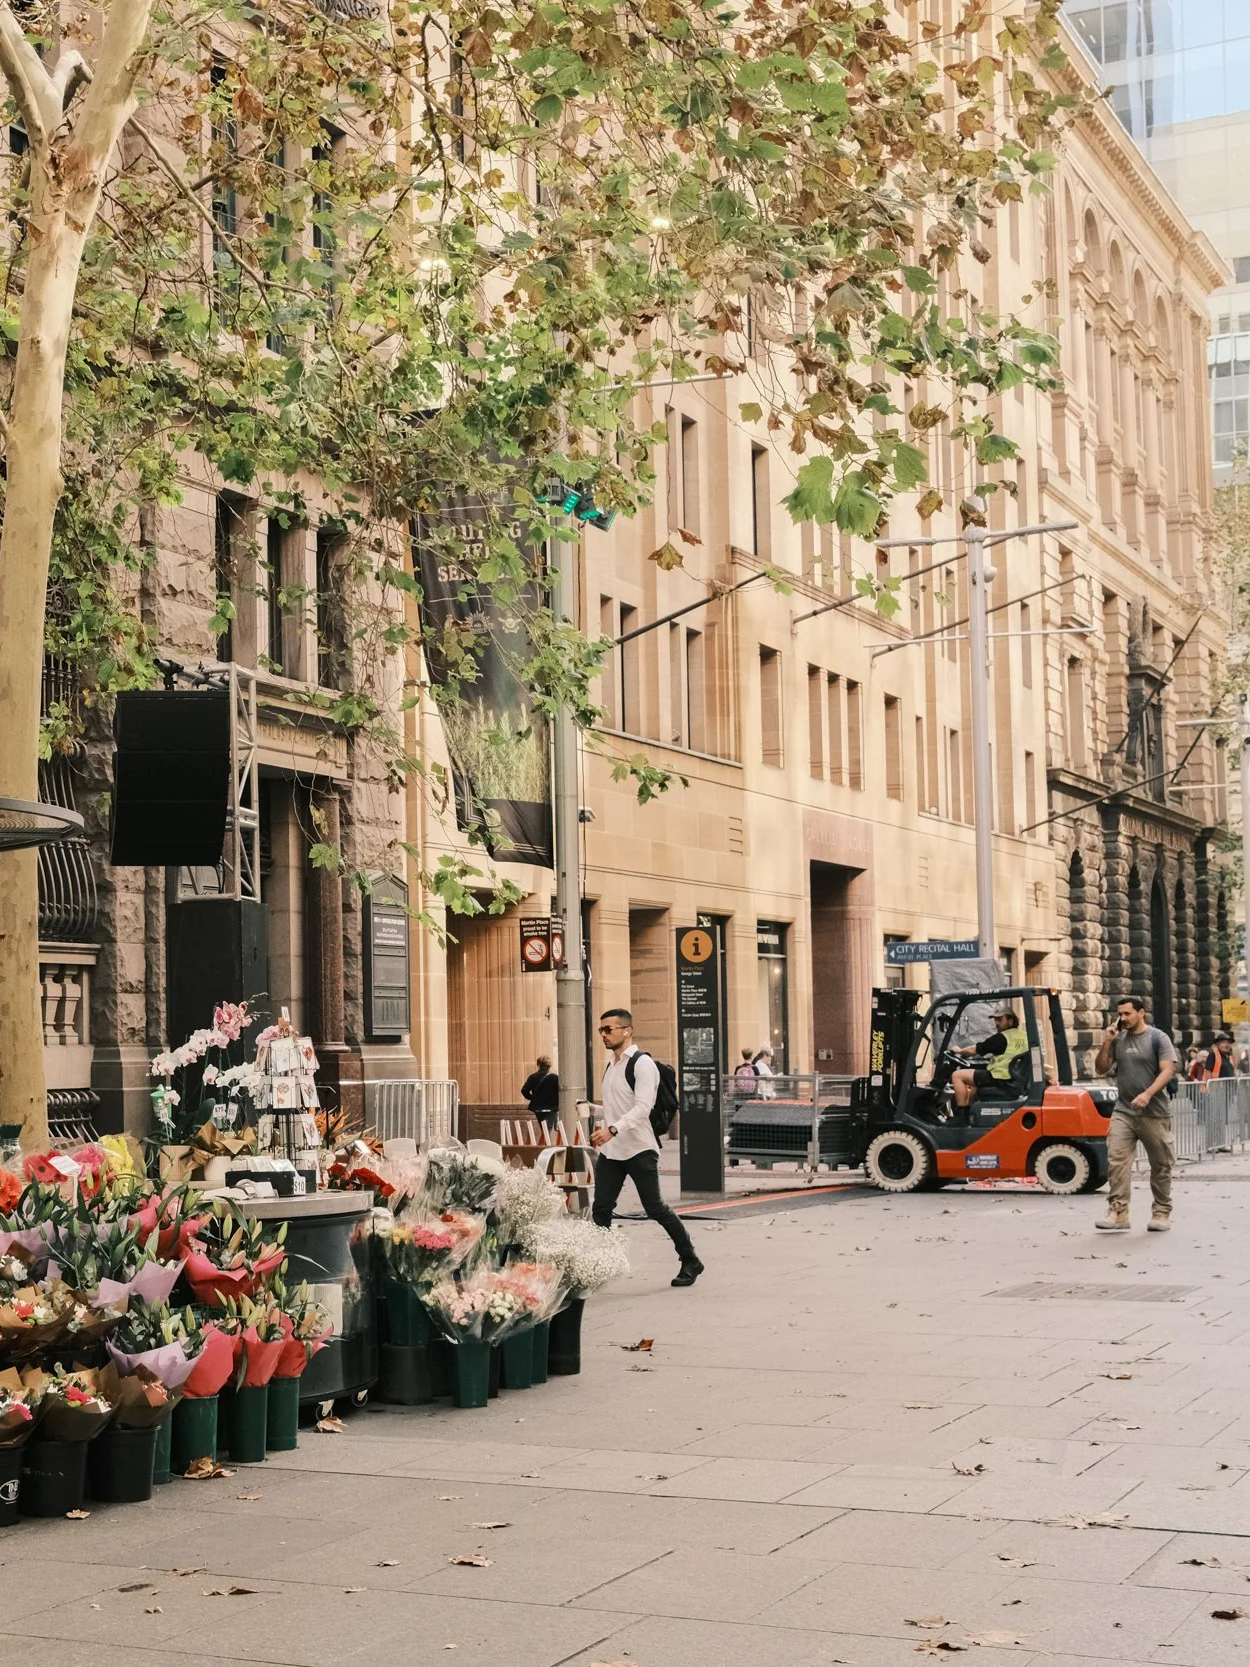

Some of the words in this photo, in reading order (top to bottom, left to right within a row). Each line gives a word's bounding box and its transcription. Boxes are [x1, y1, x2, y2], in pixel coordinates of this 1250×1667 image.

[896, 945, 917, 954] CITY
[918, 944, 951, 953] RECITAL
[953, 943, 975, 952] HALL
[877, 1031, 885, 1073] FORKLIFTS
[981, 1108, 1001, 1116] 25
[294, 1181, 304, 1192] $10
